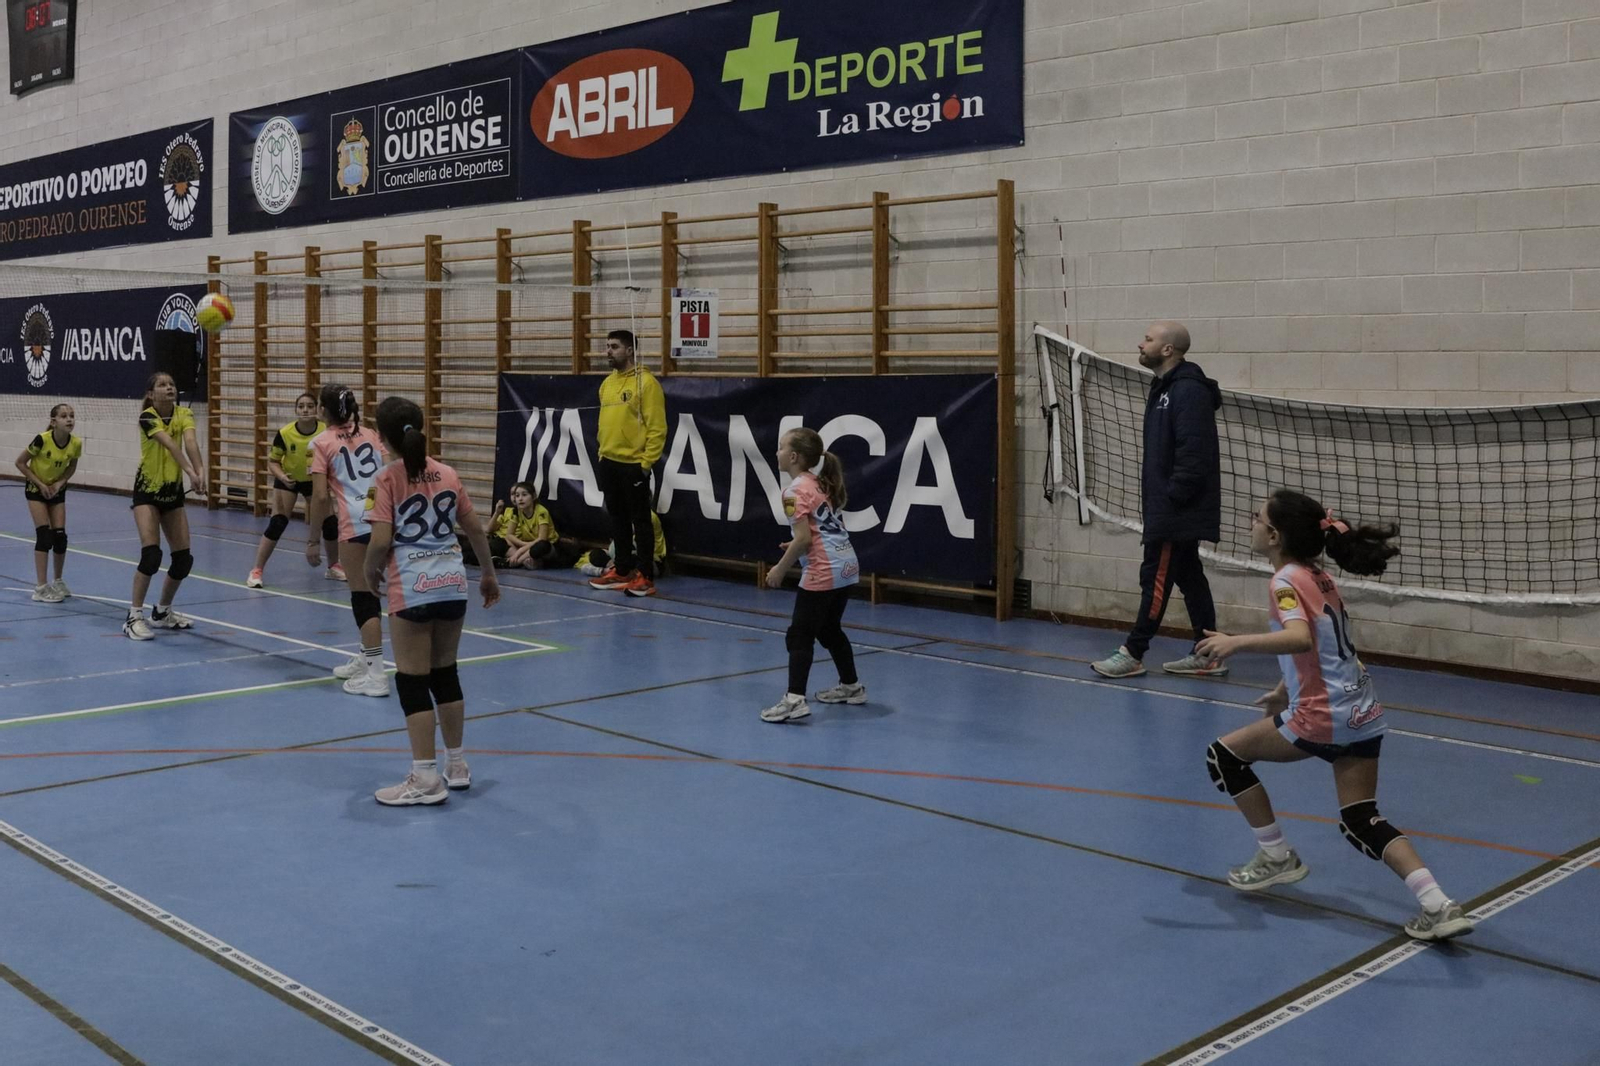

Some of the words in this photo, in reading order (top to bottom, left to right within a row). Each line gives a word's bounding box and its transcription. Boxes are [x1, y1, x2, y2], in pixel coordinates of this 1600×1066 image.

[384, 95, 456, 131] Concello
[461, 90, 484, 118] de
[546, 66, 674, 142] ABRIL
[817, 109, 860, 138] La
[158, 157, 168, 179] IES
[166, 134, 184, 154] Otero
[184, 132, 205, 172] Pedrayo
[254, 146, 262, 196] CONSELLO
[260, 122, 286, 144] MUNICIPAL
[286, 128, 294, 138] DE
[290, 140, 300, 192] DEPORTES
[384, 116, 502, 163] OURENSE
[66, 172, 78, 198] O
[81, 158, 148, 196] POMPEO
[384, 165, 437, 187] Concellería
[439, 163, 452, 179] de
[455, 158, 504, 180] Deportes
[79, 200, 147, 232] OURENSE
[264, 195, 287, 208] OURENSE
[168, 213, 195, 231] Ourense
[680, 300, 710, 312] PISTA
[690, 314, 700, 338] 1
[339, 442, 378, 481] 13
[394, 490, 457, 544] 38
